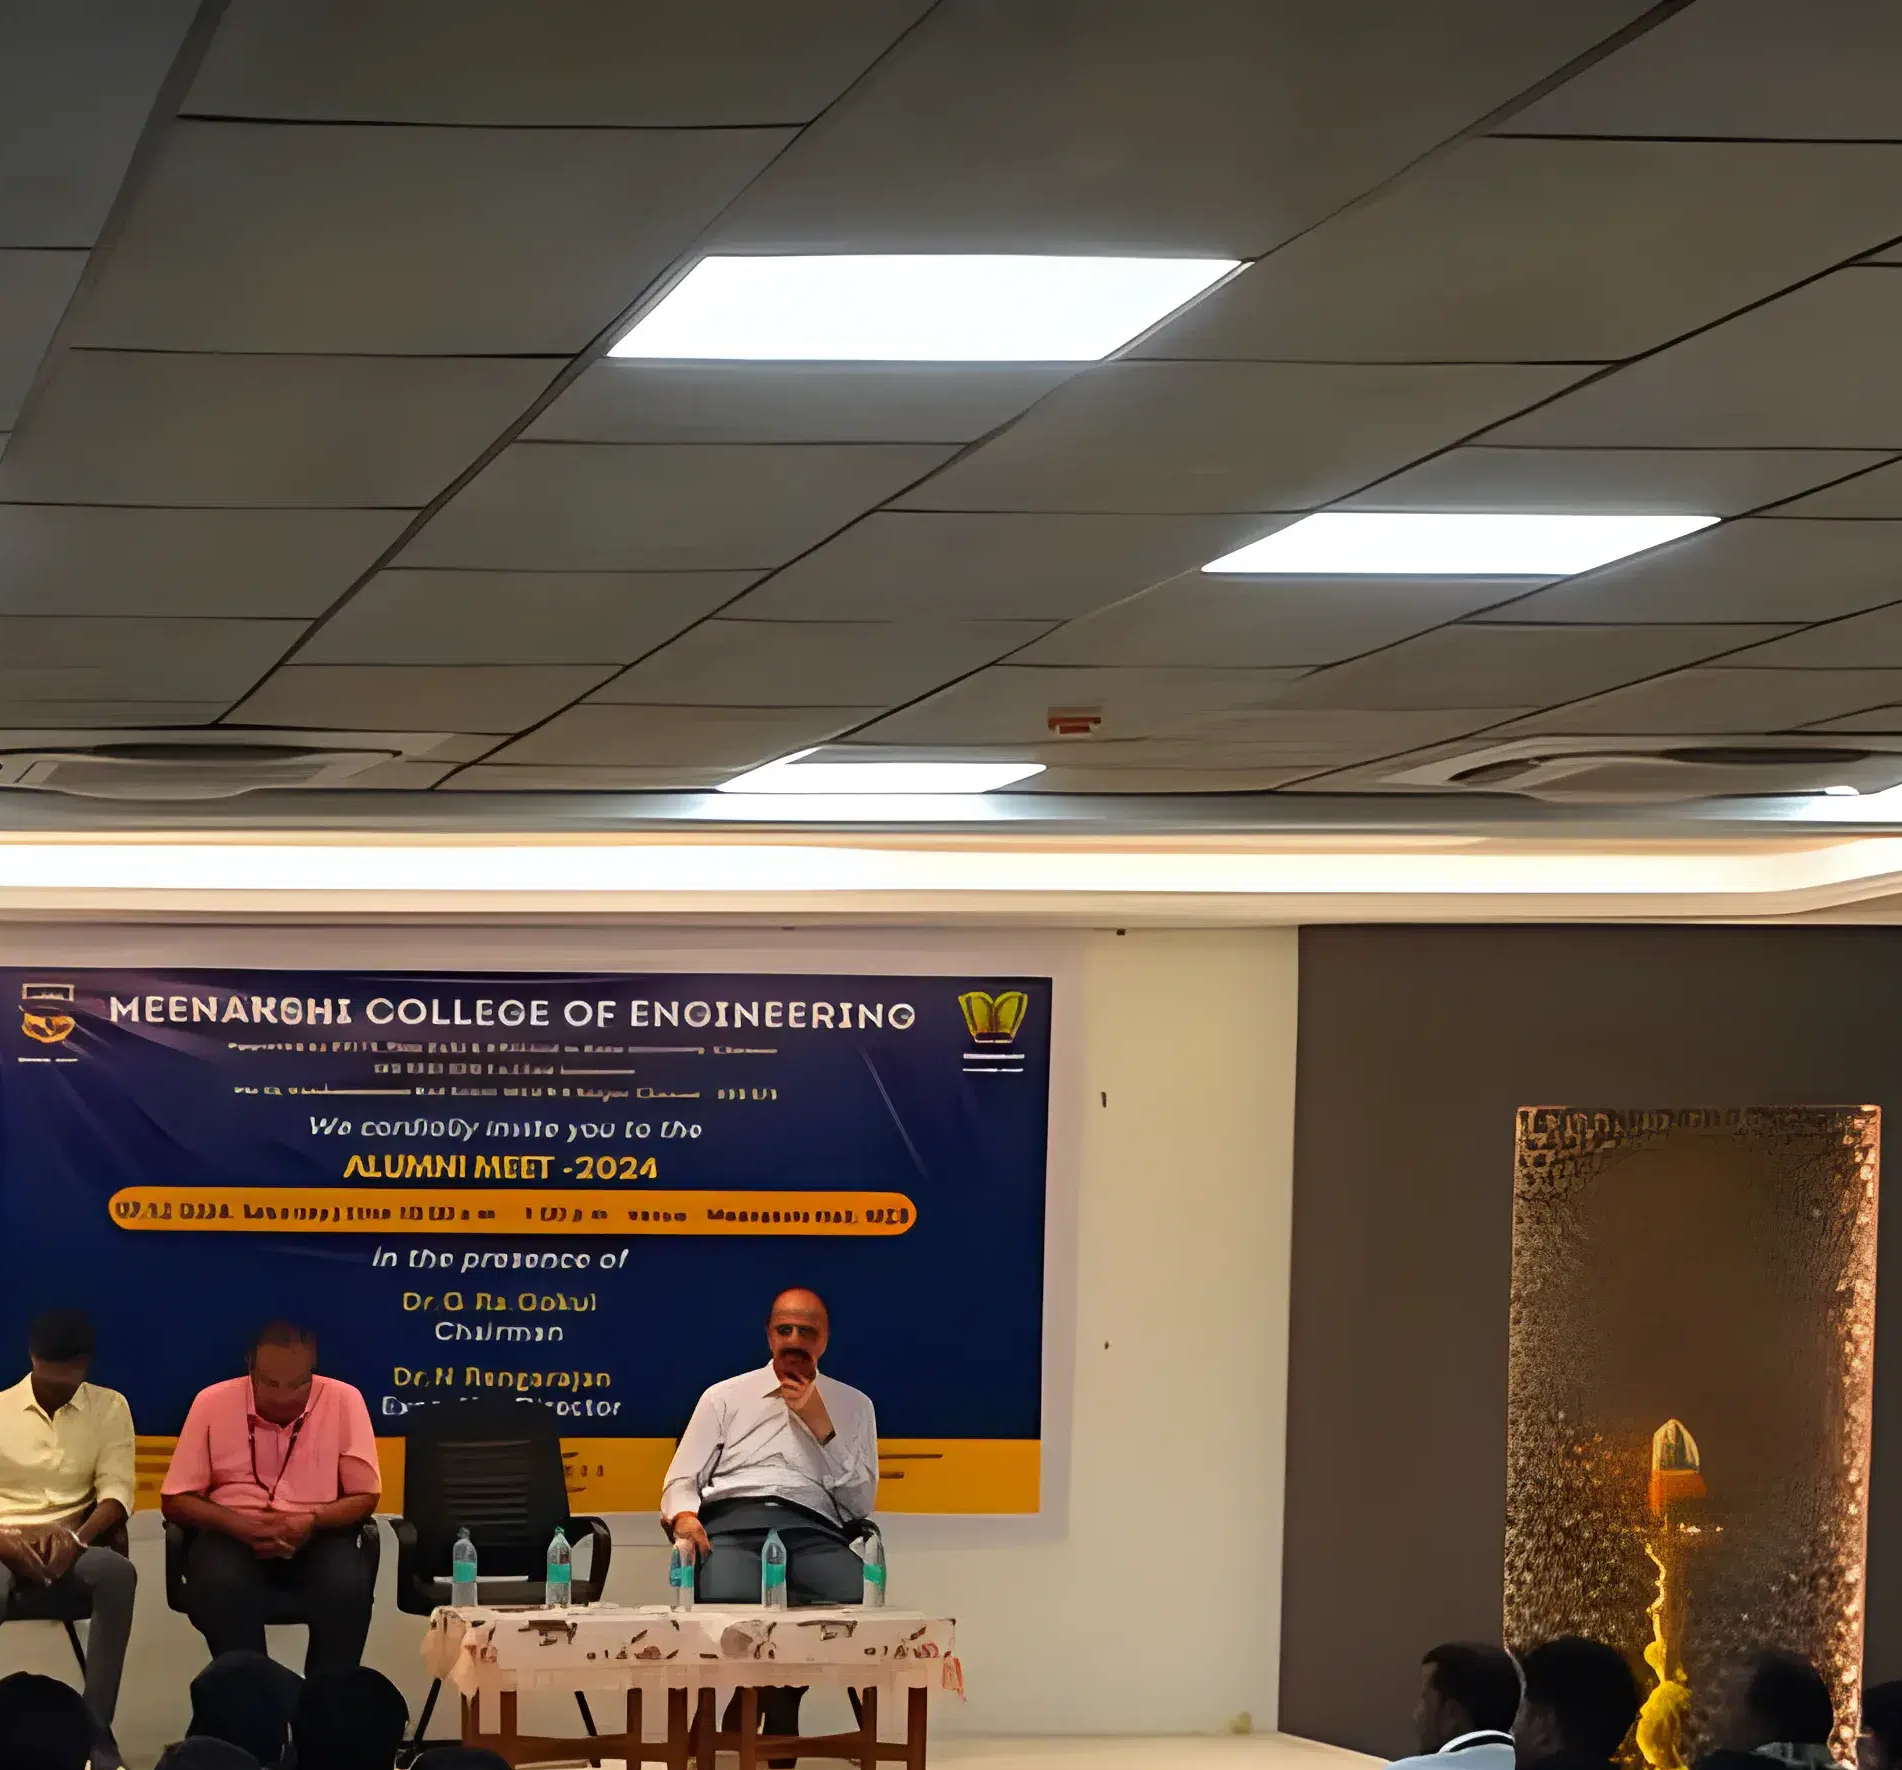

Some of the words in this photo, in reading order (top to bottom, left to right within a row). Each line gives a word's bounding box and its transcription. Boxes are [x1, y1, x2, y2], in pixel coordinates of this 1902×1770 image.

[109, 995, 353, 1026] MEENAKSHI
[365, 998, 550, 1027] COLLEGE
[563, 999, 617, 1028] OF
[630, 999, 916, 1029] ENGINEERING
[309, 1116, 352, 1136] We
[566, 1122, 616, 1143] you
[625, 1121, 652, 1138] to
[660, 1120, 703, 1139] the
[343, 1154, 466, 1179] ALUMNI
[474, 1154, 556, 1180] MEET
[408, 1248, 454, 1269] the
[460, 1252, 592, 1274] presence
[599, 1248, 630, 1269] of
[435, 1321, 565, 1342] Chairman
